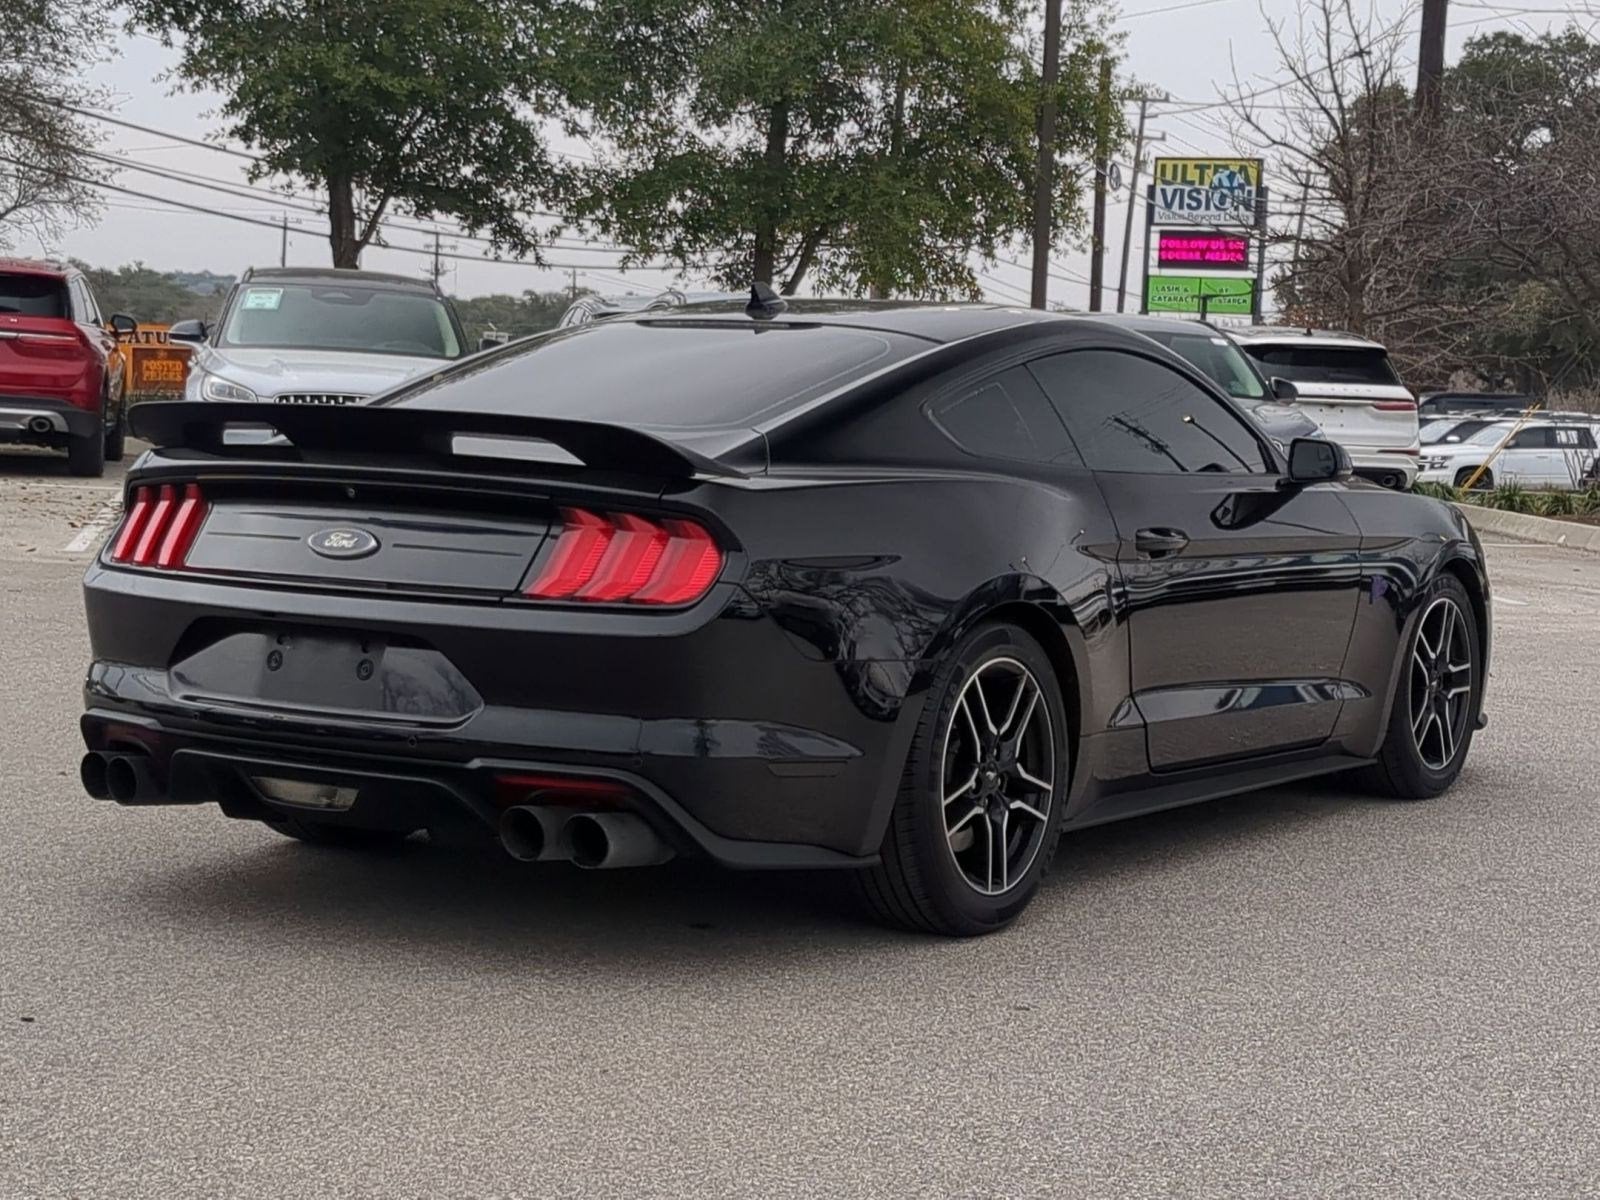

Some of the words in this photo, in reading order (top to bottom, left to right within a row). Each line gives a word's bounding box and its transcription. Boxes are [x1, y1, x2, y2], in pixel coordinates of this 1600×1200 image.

[1160, 164, 1252, 186] ULTRA
[1160, 187, 1253, 211] VISION
[1188, 212, 1221, 223] Beyond
[1160, 239, 1208, 249] FOLLOW
[1209, 239, 1225, 249] US
[1160, 251, 1201, 260] SOCIAL
[1155, 285, 1181, 293] LASIK
[1151, 295, 1195, 304] CATARACT
[143, 360, 183, 371] POSTED
[324, 532, 359, 548] Ford
